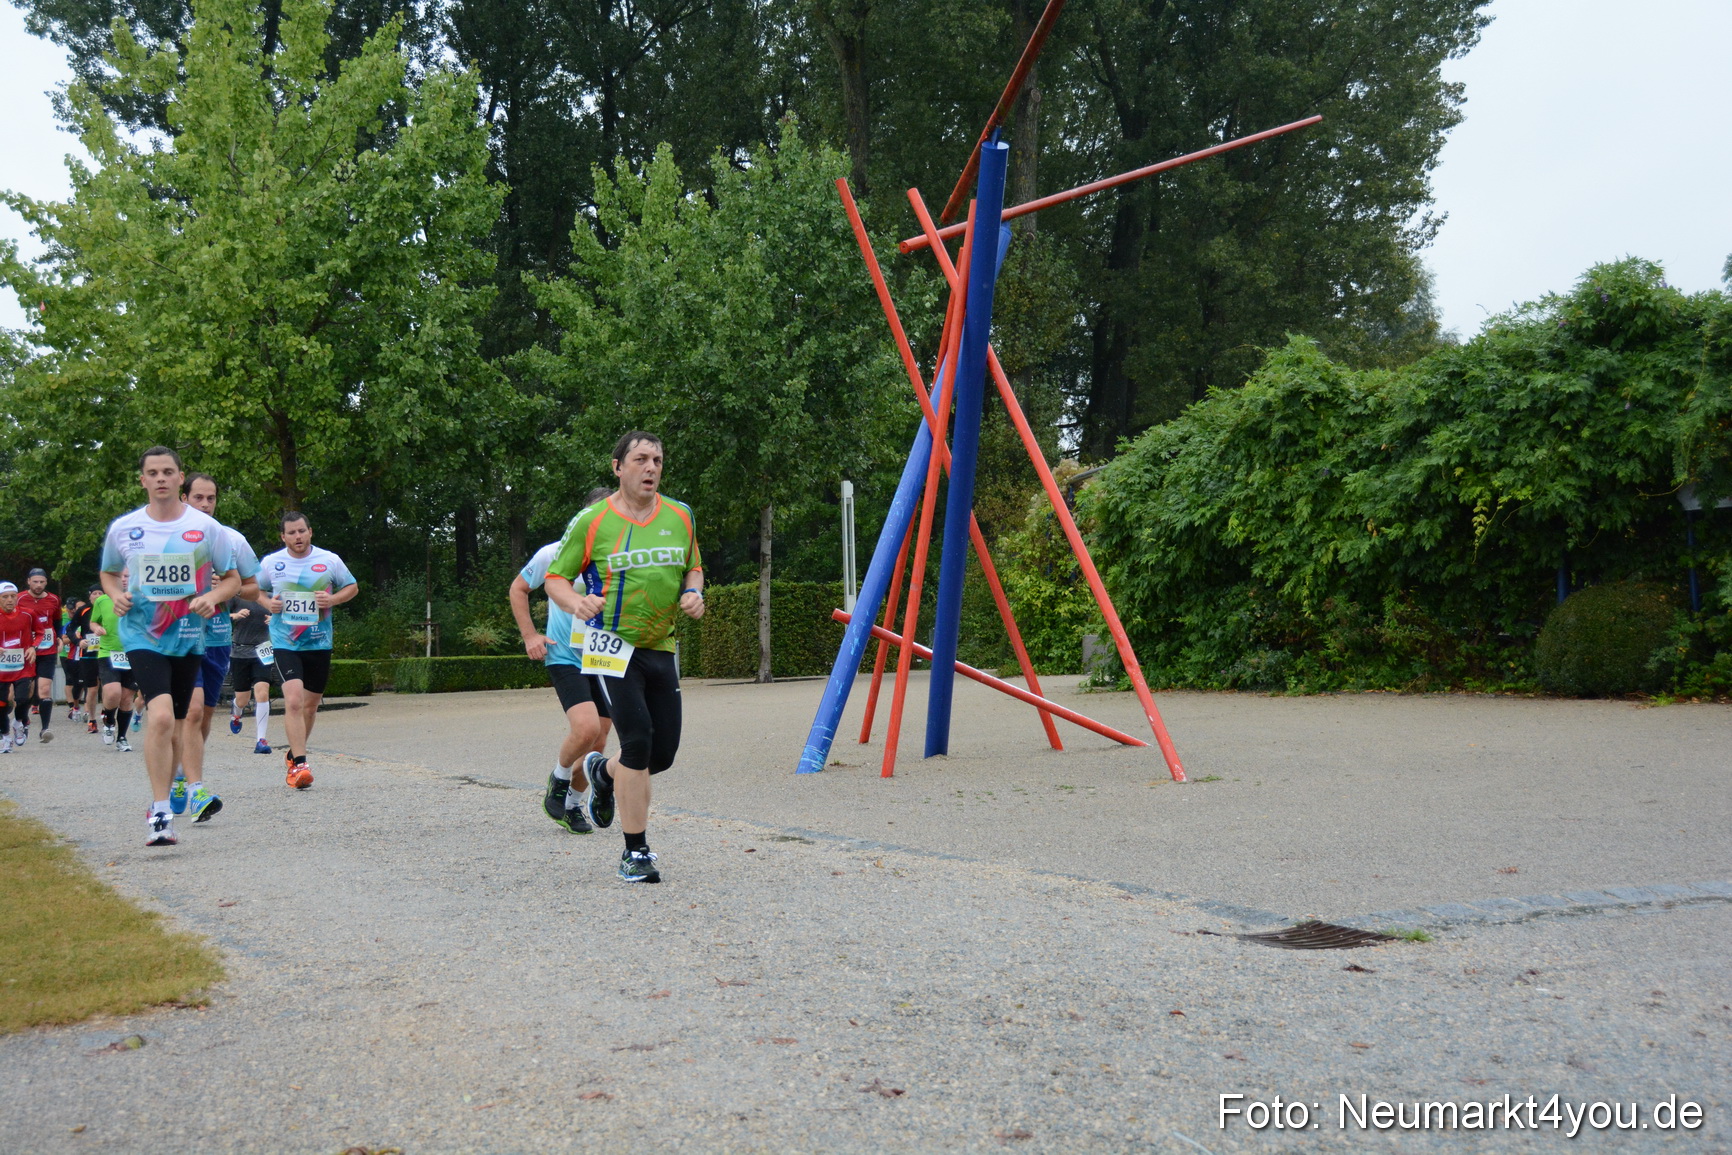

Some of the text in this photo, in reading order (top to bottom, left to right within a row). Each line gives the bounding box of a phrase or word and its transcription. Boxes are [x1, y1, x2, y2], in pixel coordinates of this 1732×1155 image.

[607, 547, 685, 572] BOCK
[145, 565, 191, 583] 2488
[152, 587, 185, 595] Christian
[285, 600, 316, 612] 2514
[180, 618, 191, 627] 17.
[589, 631, 623, 655] 339
[0, 654, 22, 663] 2462
[590, 657, 612, 668] Markus
